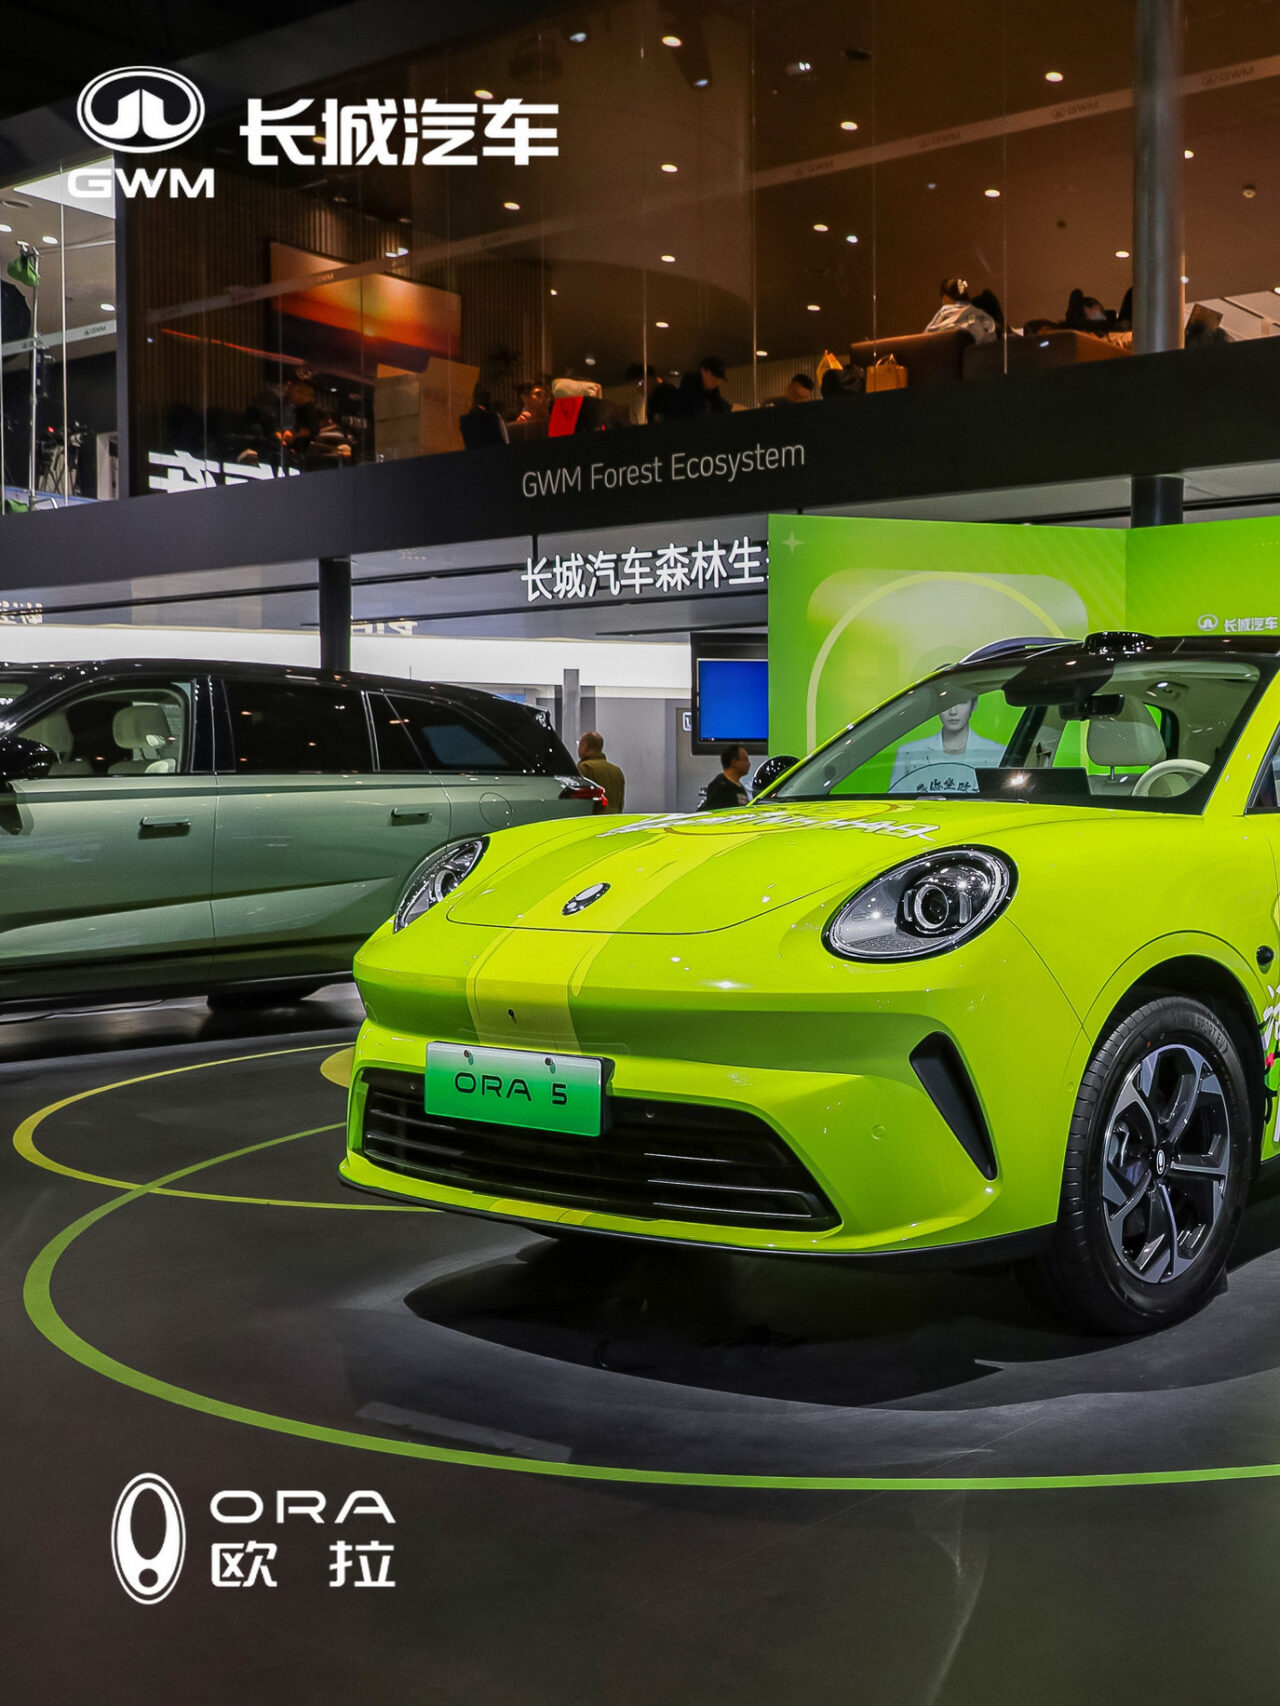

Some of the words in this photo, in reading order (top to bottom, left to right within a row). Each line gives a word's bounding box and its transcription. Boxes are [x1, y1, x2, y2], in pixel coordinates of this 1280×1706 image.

[522, 466, 582, 498] GWM
[591, 456, 663, 490] Forest
[671, 443, 806, 482] Ecosystem
[521, 536, 769, 602] 长城汽车森林生
[1223, 616, 1279, 633] 长城汽车
[454, 1072, 533, 1102] ORA
[551, 1083, 568, 1106] 5
